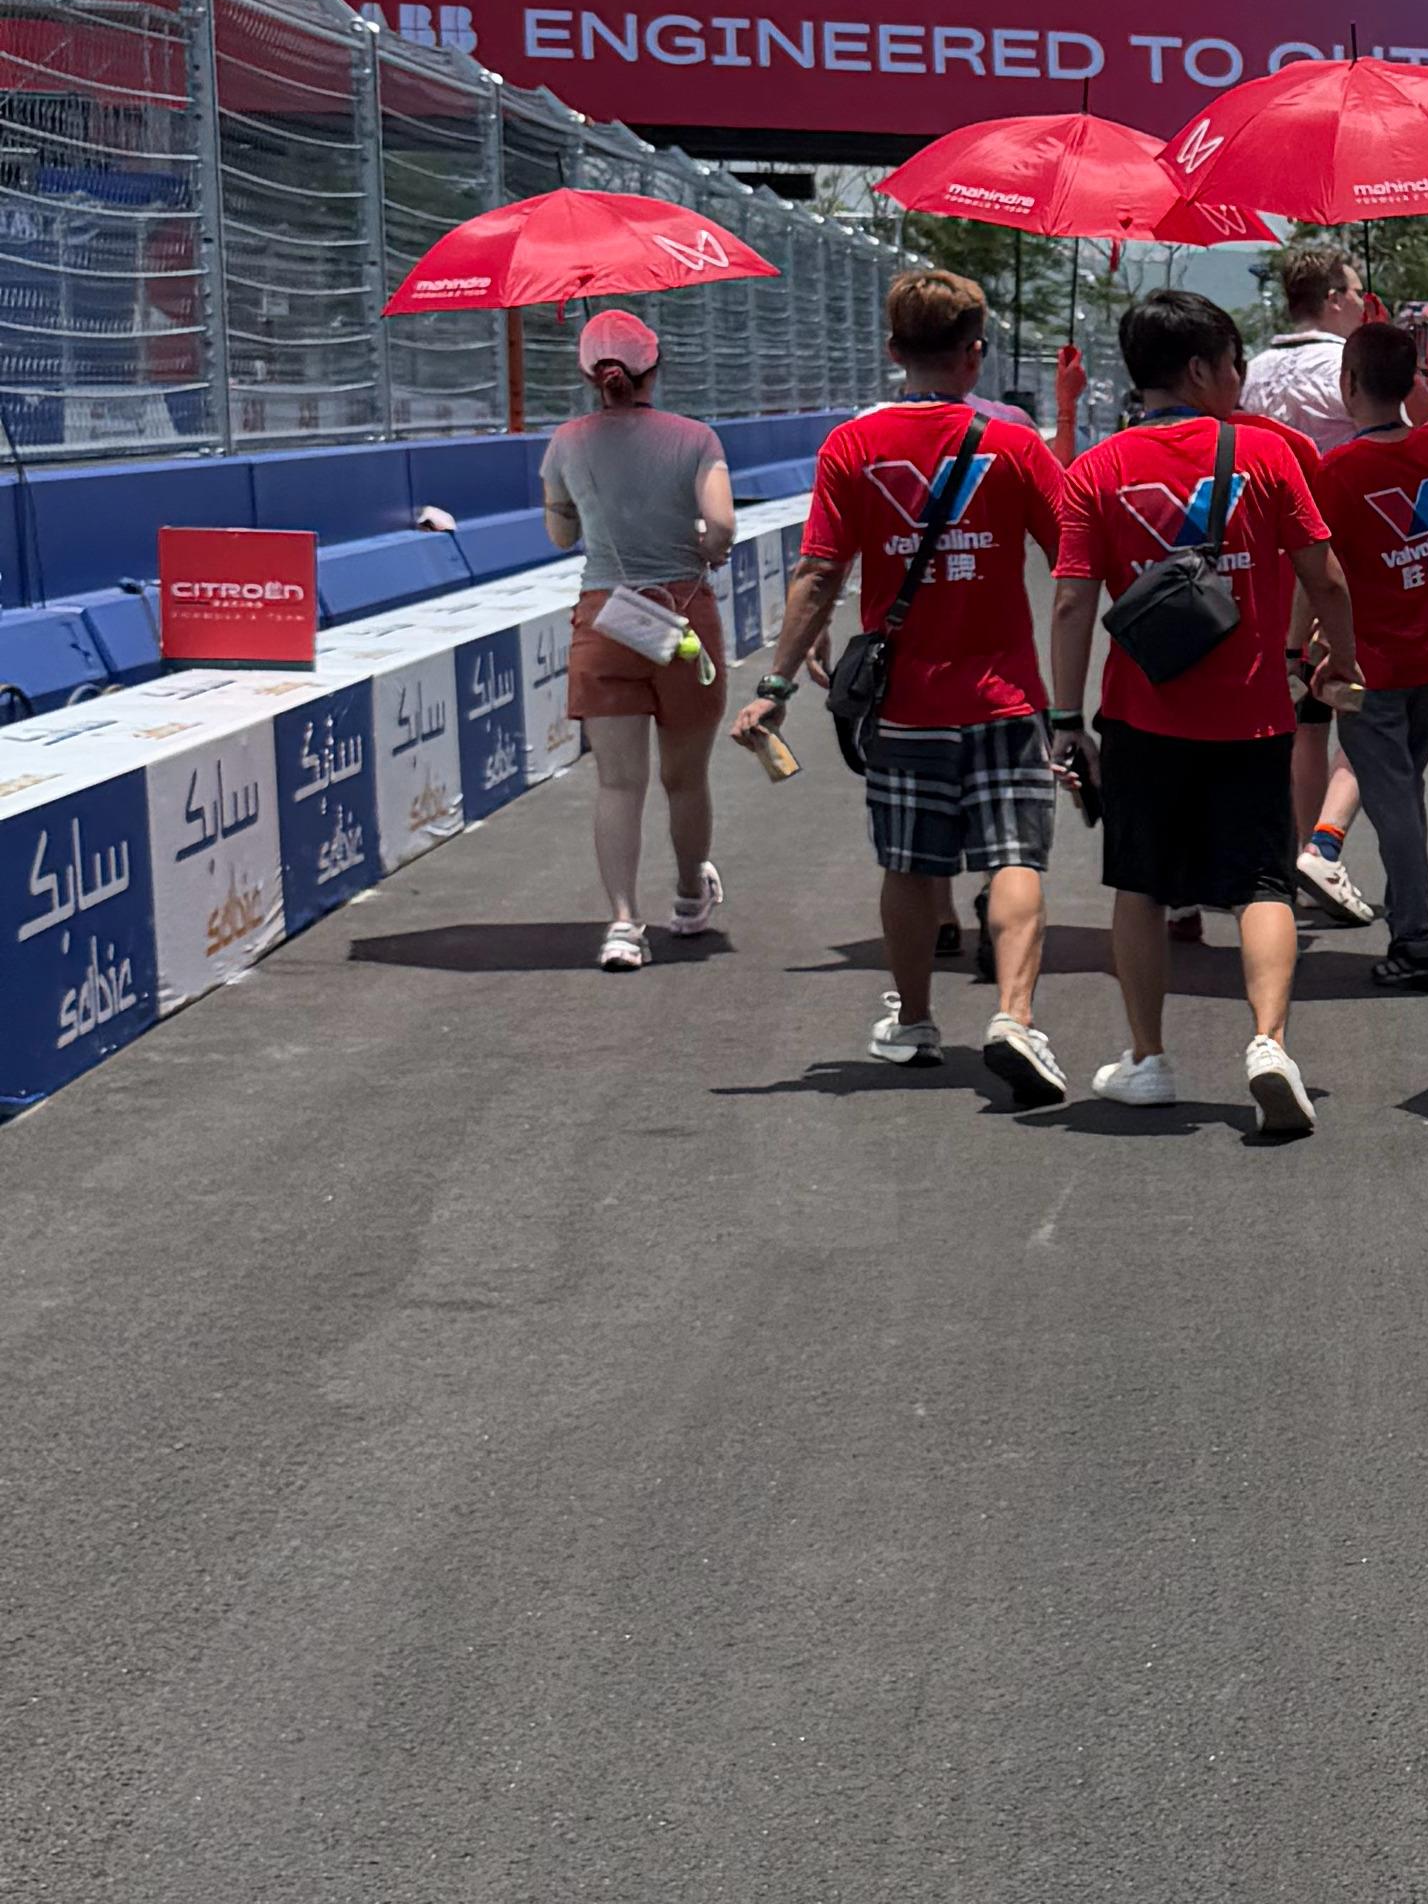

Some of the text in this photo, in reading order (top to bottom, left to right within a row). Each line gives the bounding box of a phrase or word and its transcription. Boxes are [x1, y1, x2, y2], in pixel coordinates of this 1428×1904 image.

[523, 8, 1105, 80] ENGINEERED
[1129, 34, 1244, 88] TO
[883, 528, 994, 556] Valoline
[17, 816, 131, 955] سابك
[56, 935, 138, 1050] sabic
